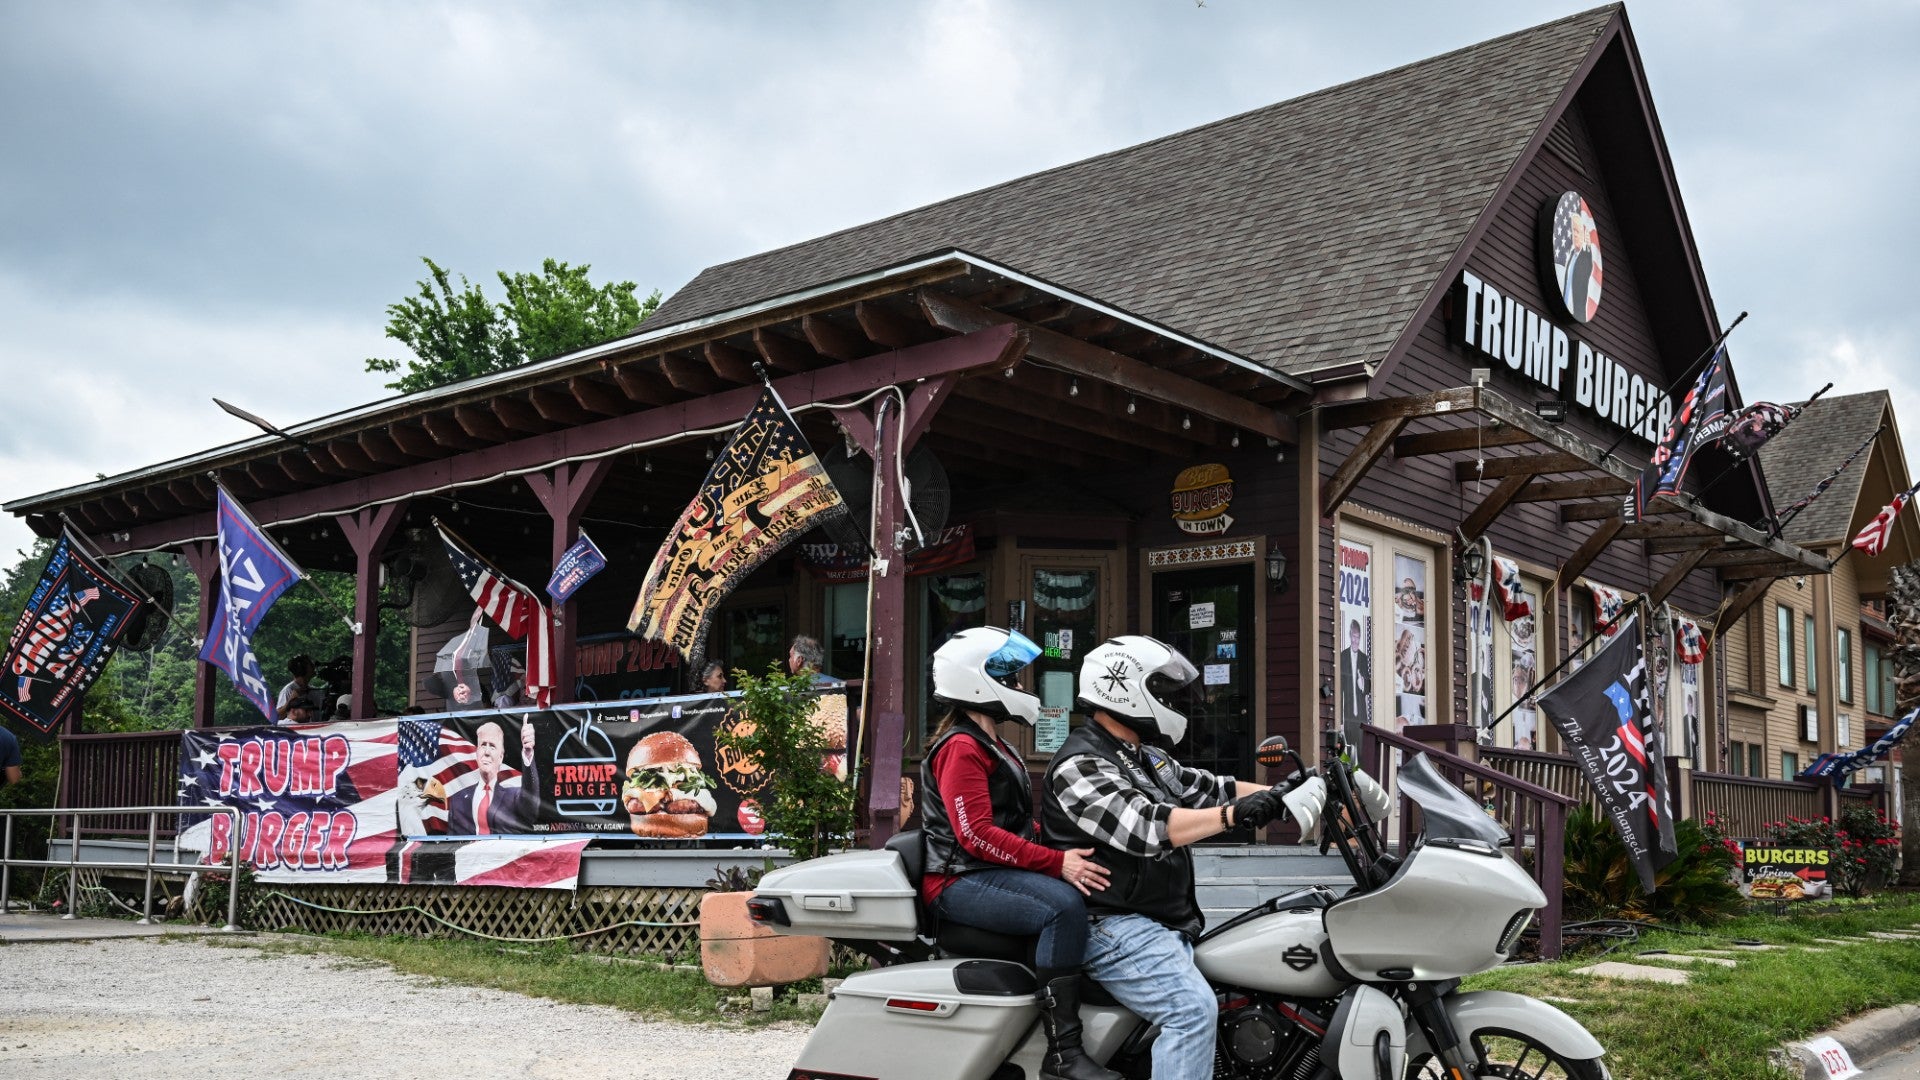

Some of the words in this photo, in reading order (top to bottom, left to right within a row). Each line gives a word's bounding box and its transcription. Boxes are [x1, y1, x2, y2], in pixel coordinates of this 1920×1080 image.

[1463, 270, 1568, 392] TRUMP
[1576, 340, 1672, 445] BURGER
[1172, 483, 1233, 512] BURGERS
[1183, 521, 1192, 530] IN
[1195, 516, 1226, 531] TOWN
[559, 555, 580, 576] 2024
[1339, 544, 1369, 572] TRUMP
[1339, 571, 1369, 608] 2024
[626, 639, 680, 673] 2024
[1104, 652, 1143, 673] REMEMBER
[1092, 681, 1103, 696] THE
[1102, 693, 1130, 704] FALLEN
[217, 735, 350, 800] TRUMP
[553, 764, 617, 785] TRUMP
[1598, 734, 1649, 811] 2024
[554, 783, 618, 797] BURGER
[1562, 717, 1583, 745] The
[1578, 744, 1599, 775] rules
[1593, 774, 1613, 804] have
[1612, 804, 1648, 861] changed.
[210, 808, 357, 871] BURGER
[954, 795, 974, 840] REMEMBER
[971, 835, 985, 849] THE
[985, 843, 1018, 865] FALLEN
[1745, 848, 1830, 865] BURGERS
[1747, 868, 1756, 877] &
[1759, 865, 1794, 878] Fries
[1821, 1049, 1847, 1074] 233
